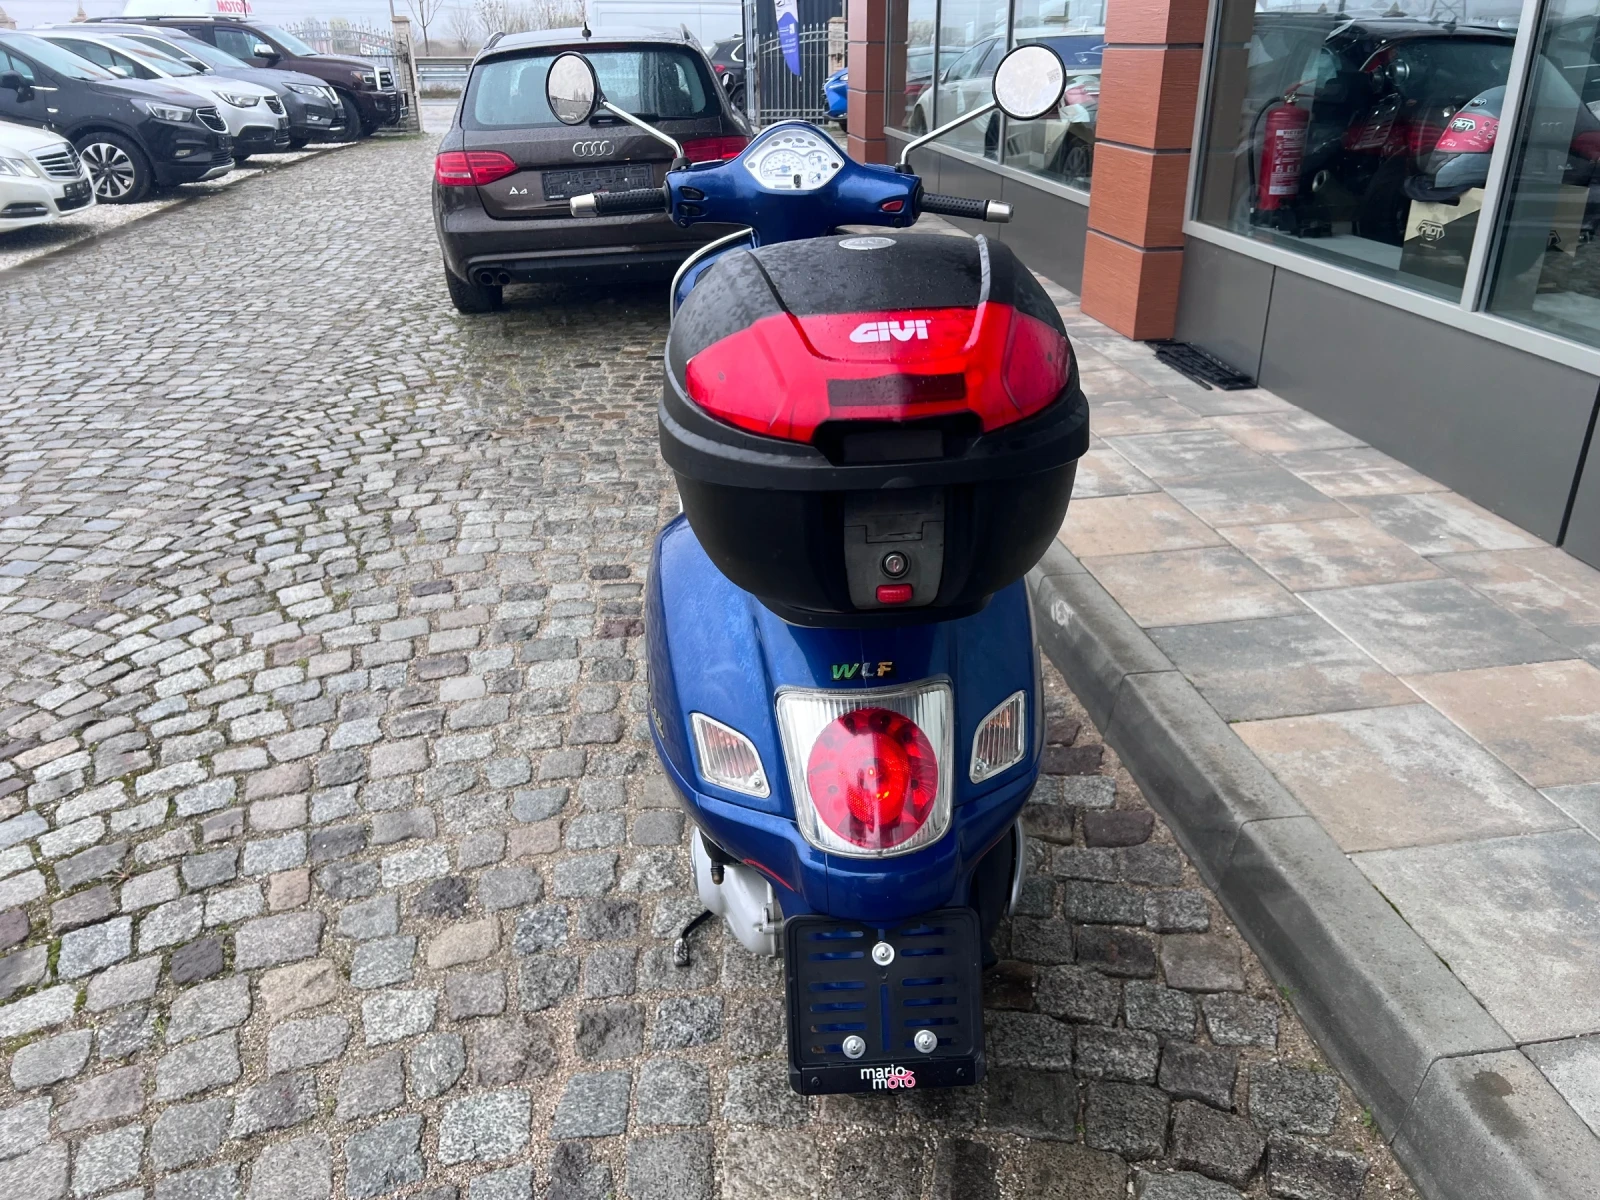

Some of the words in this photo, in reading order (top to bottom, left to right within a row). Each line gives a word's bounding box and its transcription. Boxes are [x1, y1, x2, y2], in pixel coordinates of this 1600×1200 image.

[509, 186, 528, 195] A4
[849, 319, 930, 343] GIVI
[831, 661, 893, 680] WLF
[860, 1063, 906, 1080] mario
[872, 1076, 916, 1090] moto
